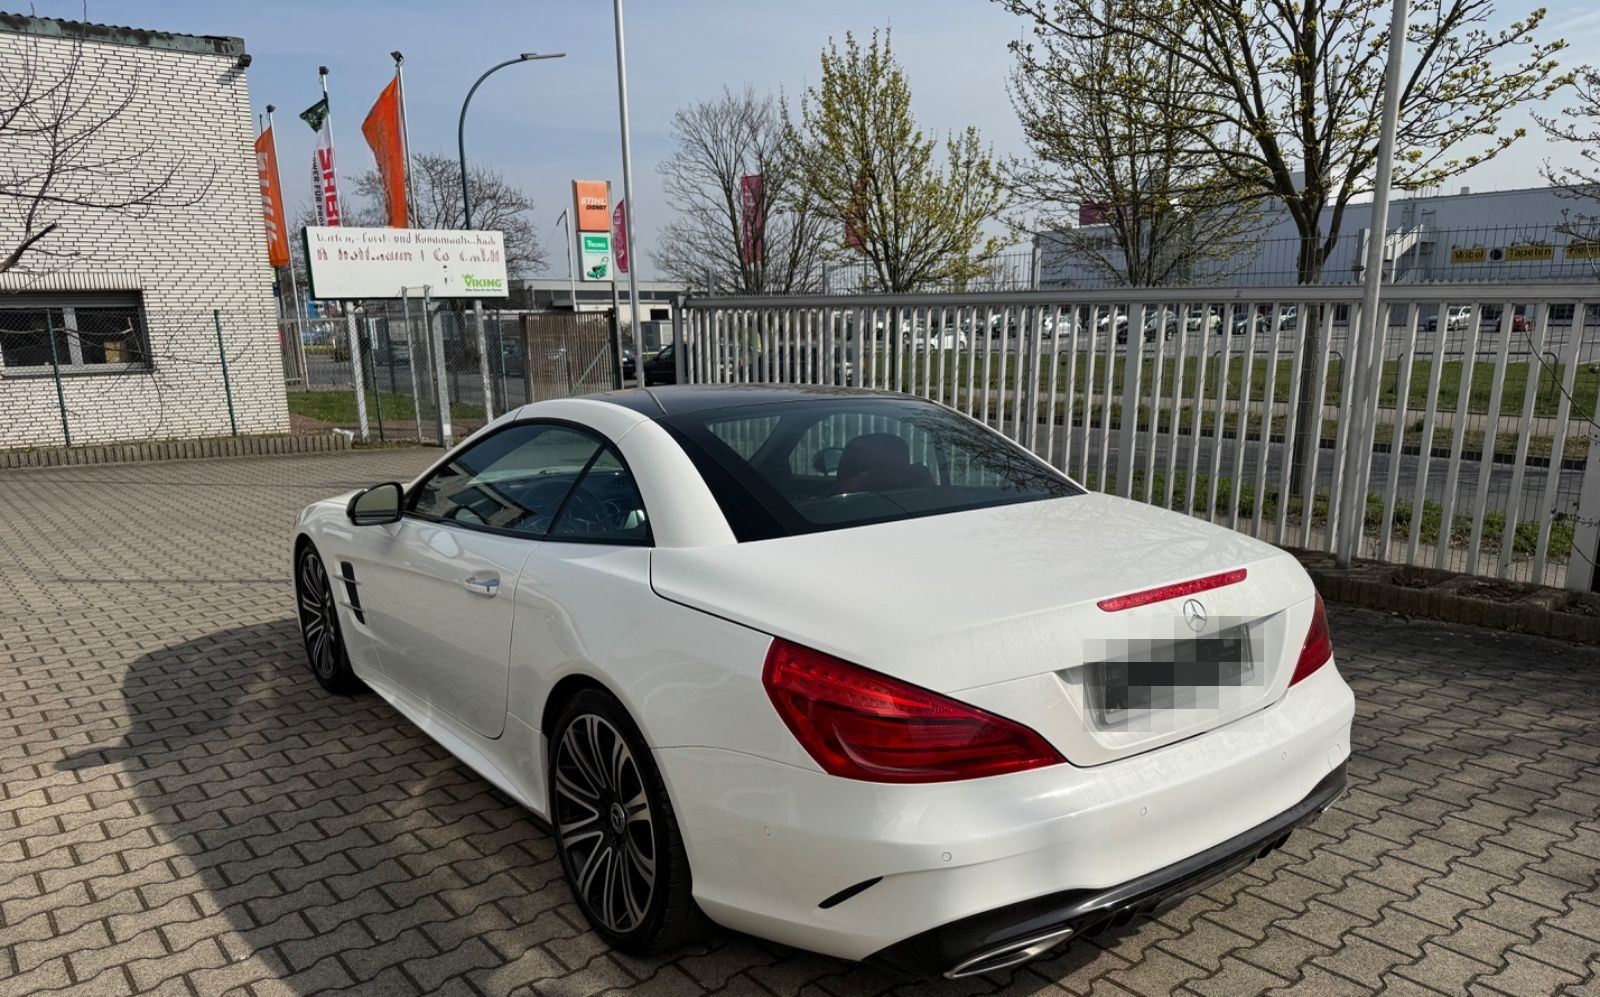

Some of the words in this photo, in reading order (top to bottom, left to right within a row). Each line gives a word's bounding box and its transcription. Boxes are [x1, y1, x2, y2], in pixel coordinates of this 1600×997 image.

[314, 185, 323, 203] FÜR
[1509, 247, 1551, 257] Tapeten
[463, 276, 502, 288] VIKING
